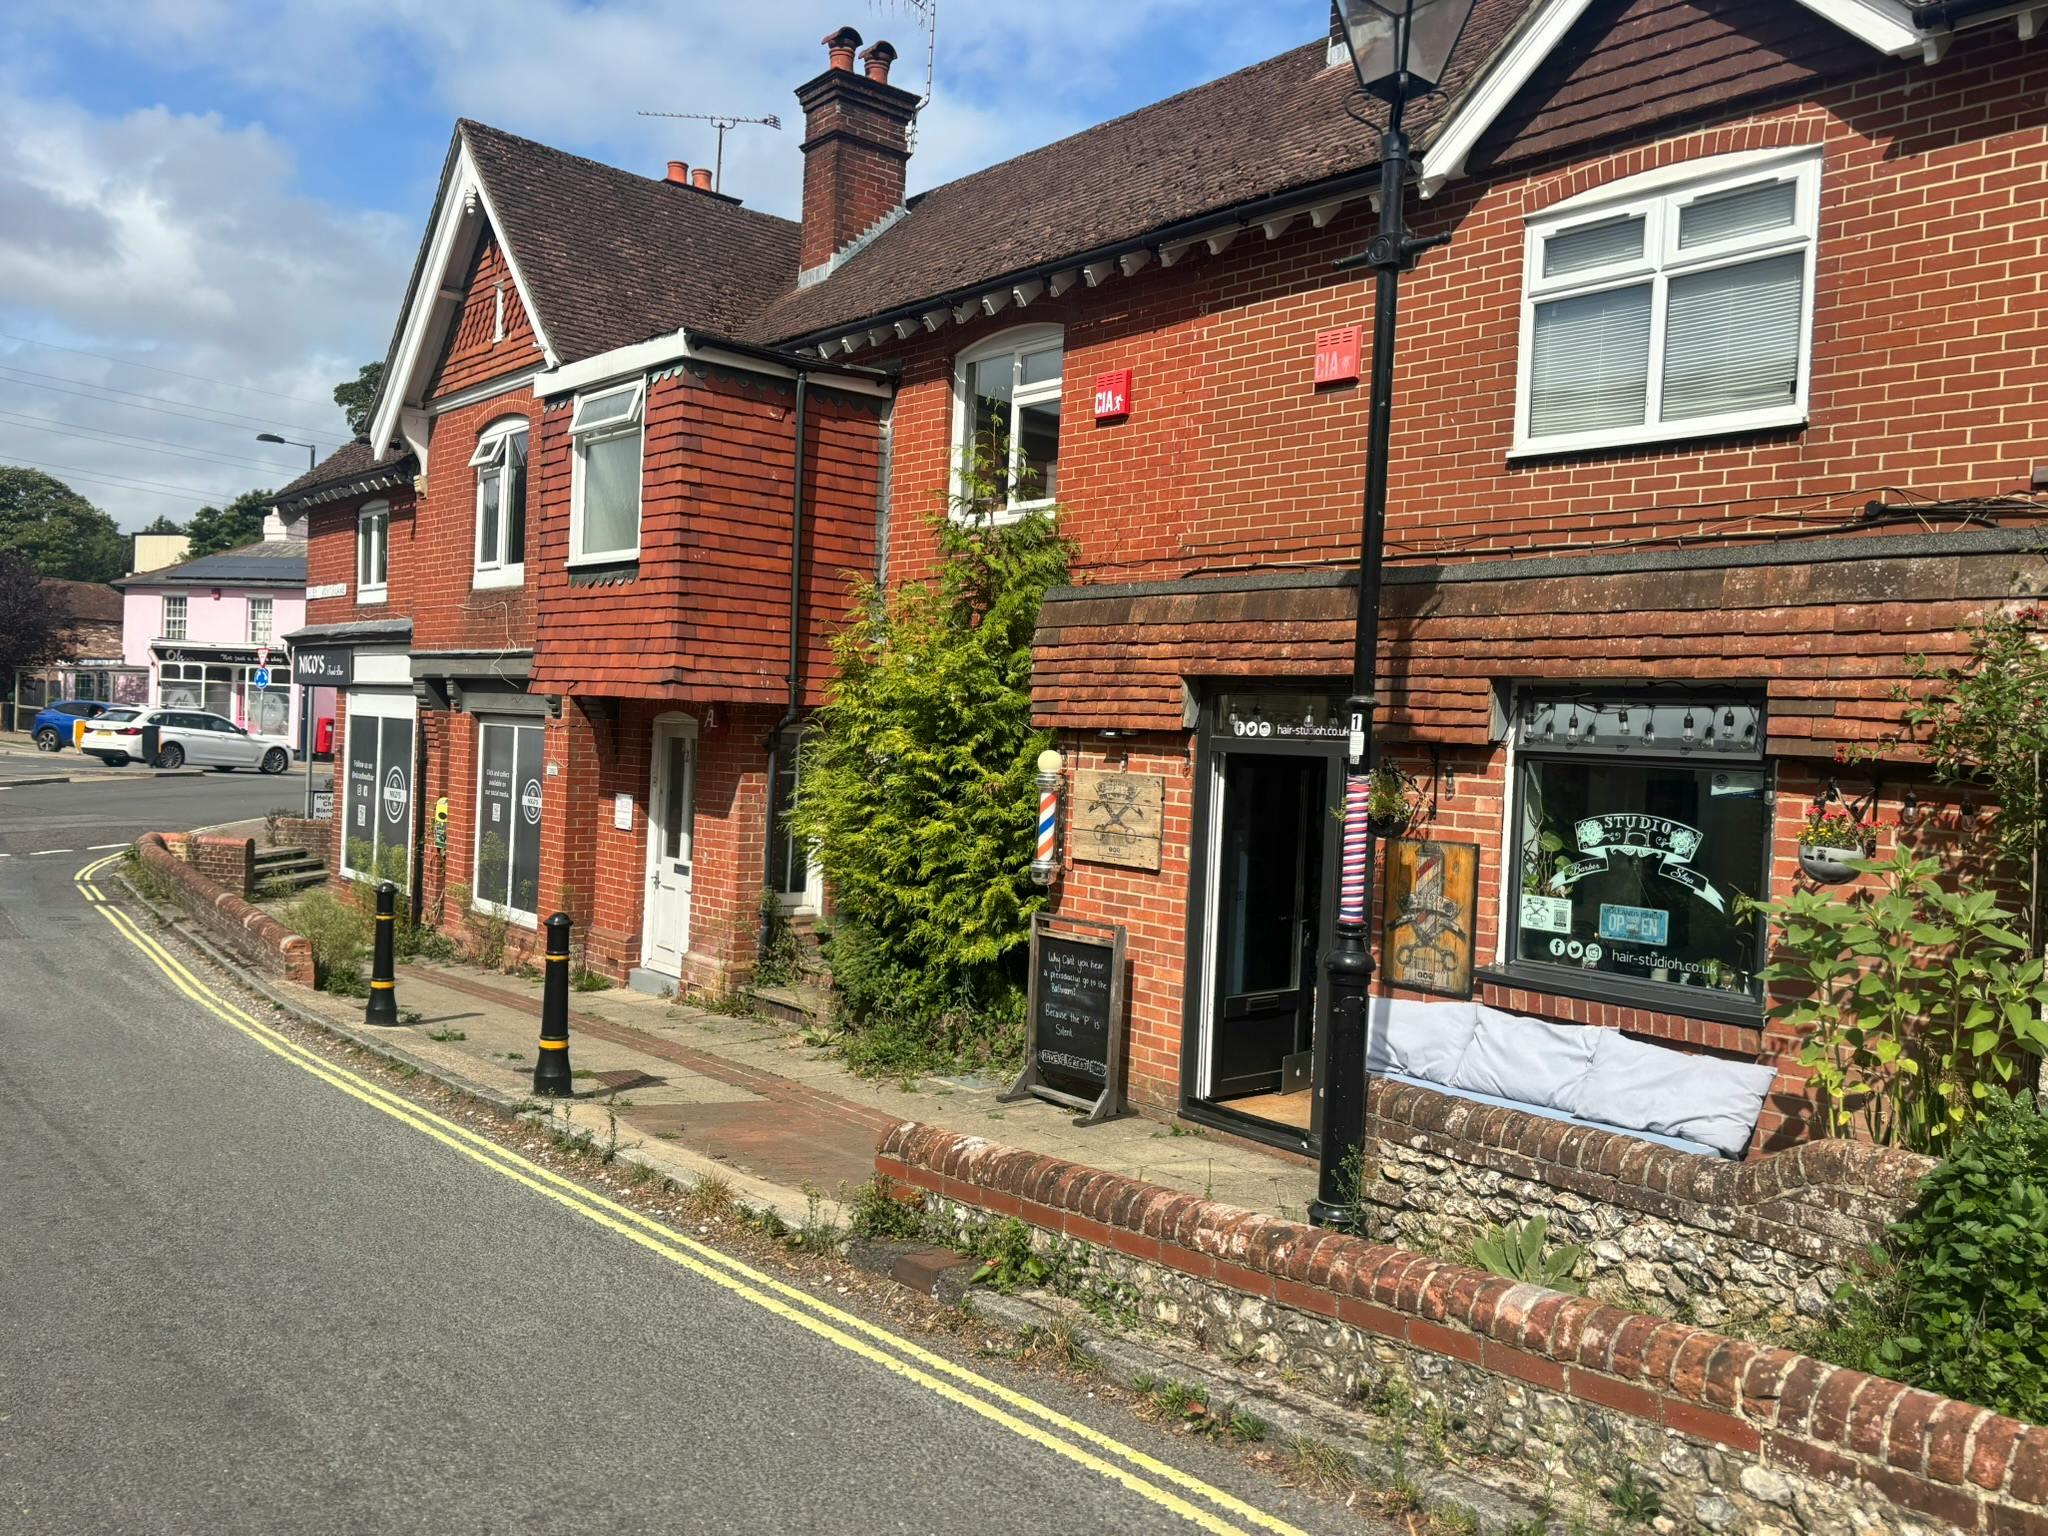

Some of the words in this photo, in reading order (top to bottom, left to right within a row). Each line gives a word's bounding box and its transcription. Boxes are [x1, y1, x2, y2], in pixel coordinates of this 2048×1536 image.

[1315, 351, 1338, 380] CIA
[1095, 390, 1113, 414] CIA
[298, 654, 325, 674] NICO'S
[1352, 714, 1359, 731] 1
[316, 794, 331, 802] Holy
[1604, 816, 1672, 835] STUDIO
[1569, 863, 1601, 876] Barber
[1670, 867, 1695, 885] Shop
[1048, 951, 1061, 972] Why
[1077, 959, 1089, 974] you
[1090, 960, 1104, 969] hear
[1612, 949, 1717, 975] hair-studioh.co.uk
[1082, 977, 1090, 989] go
[1090, 979, 1097, 987] to
[1097, 979, 1108, 990] the
[1045, 1003, 1068, 1020] Because
[1070, 1011, 1080, 1024] the
[1094, 1020, 1100, 1030] is
[1055, 1023, 1073, 1037] Silent
[1067, 1056, 1089, 1070] GREAT
